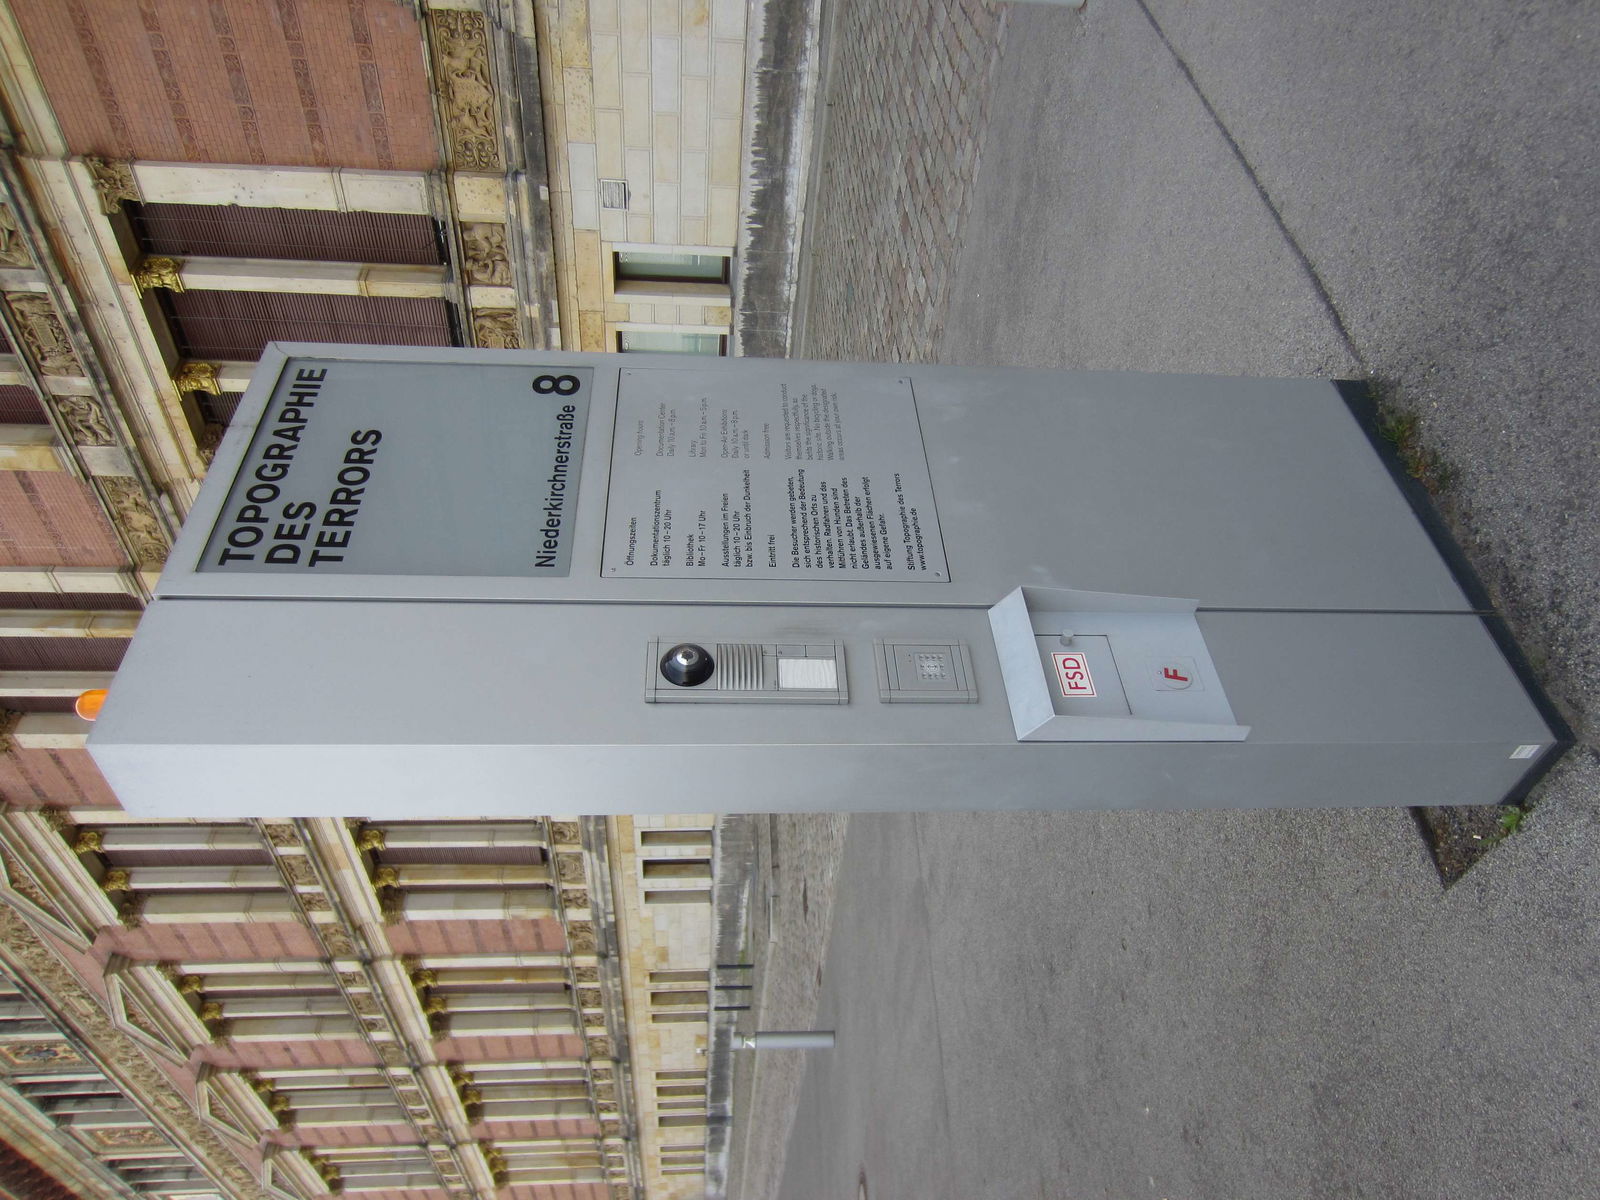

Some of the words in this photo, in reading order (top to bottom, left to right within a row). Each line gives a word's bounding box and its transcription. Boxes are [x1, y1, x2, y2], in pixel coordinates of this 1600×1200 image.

[532, 374, 580, 396] 8
[217, 368, 328, 566] TOPOGRAPHIE
[534, 404, 576, 568] Niederkirchnerstraße
[742, 470, 750, 500] Dunkelheit
[797, 469, 806, 500] Bedeutung
[831, 488, 839, 500] sind
[862, 477, 871, 495] erfolgt
[893, 473, 903, 493] Terrors
[308, 429, 383, 567] TERRORS
[799, 501, 807, 511] der
[811, 494, 817, 502] zu
[842, 489, 851, 514] Betreten
[865, 497, 874, 520] Flächen
[896, 494, 905, 504] des
[698, 510, 706, 521] Uhr
[732, 511, 740, 522] Uhr
[789, 503, 797, 524] werden
[822, 506, 832, 536] Radfahren
[833, 502, 841, 524] Hunden
[845, 516, 853, 527] Das
[856, 508, 866, 537] außerhalb
[878, 513, 888, 535] Gefahr.
[265, 501, 317, 565] DES
[650, 490, 661, 566] Dokumentationszentrum
[744, 513, 752, 540] Einbruch
[800, 512, 811, 553] entsprechend
[835, 526, 843, 537] von
[899, 506, 911, 543] Topographie
[624, 517, 637, 566] Öffnungszeiten
[721, 522, 730, 567] Ausstellungen
[767, 535, 775, 545] frei
[790, 526, 799, 555] Besucher
[812, 517, 822, 555] historischen
[869, 521, 881, 569] ausgewiesenen
[910, 508, 927, 571] www.topographie.de
[663, 545, 671, 566] täglich
[686, 534, 694, 566] Bibliothek
[733, 546, 742, 567] täglich
[768, 546, 776, 567] Eintritt
[836, 539, 847, 568] Mitführen
[859, 539, 870, 569] Geländes
[882, 537, 892, 558] eigene
[904, 545, 916, 570] Stiftung
[745, 553, 753, 567] bzw.
[803, 555, 811, 568] sich
[815, 557, 823, 568] des
[848, 553, 858, 569] nicht
[884, 559, 893, 570] auf
[1062, 657, 1088, 690] FSD
[1164, 668, 1188, 682] F
